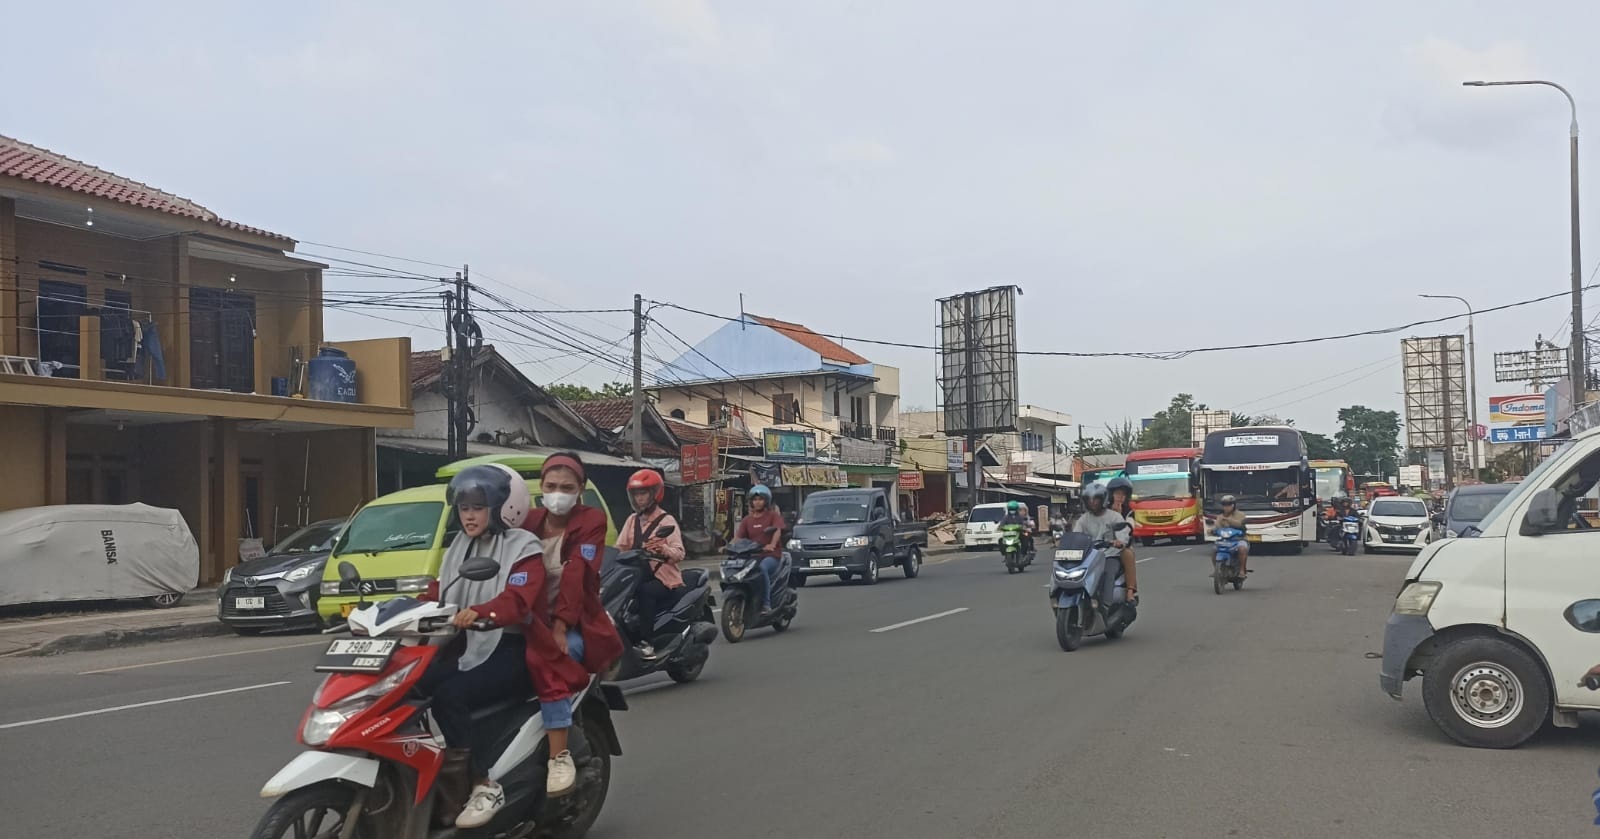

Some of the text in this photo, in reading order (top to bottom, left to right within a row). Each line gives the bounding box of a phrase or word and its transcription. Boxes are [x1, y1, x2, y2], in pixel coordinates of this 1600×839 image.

[1504, 403, 1545, 412] Indoma
[100, 529, 118, 565] BANISA
[361, 717, 391, 736] HONDA
